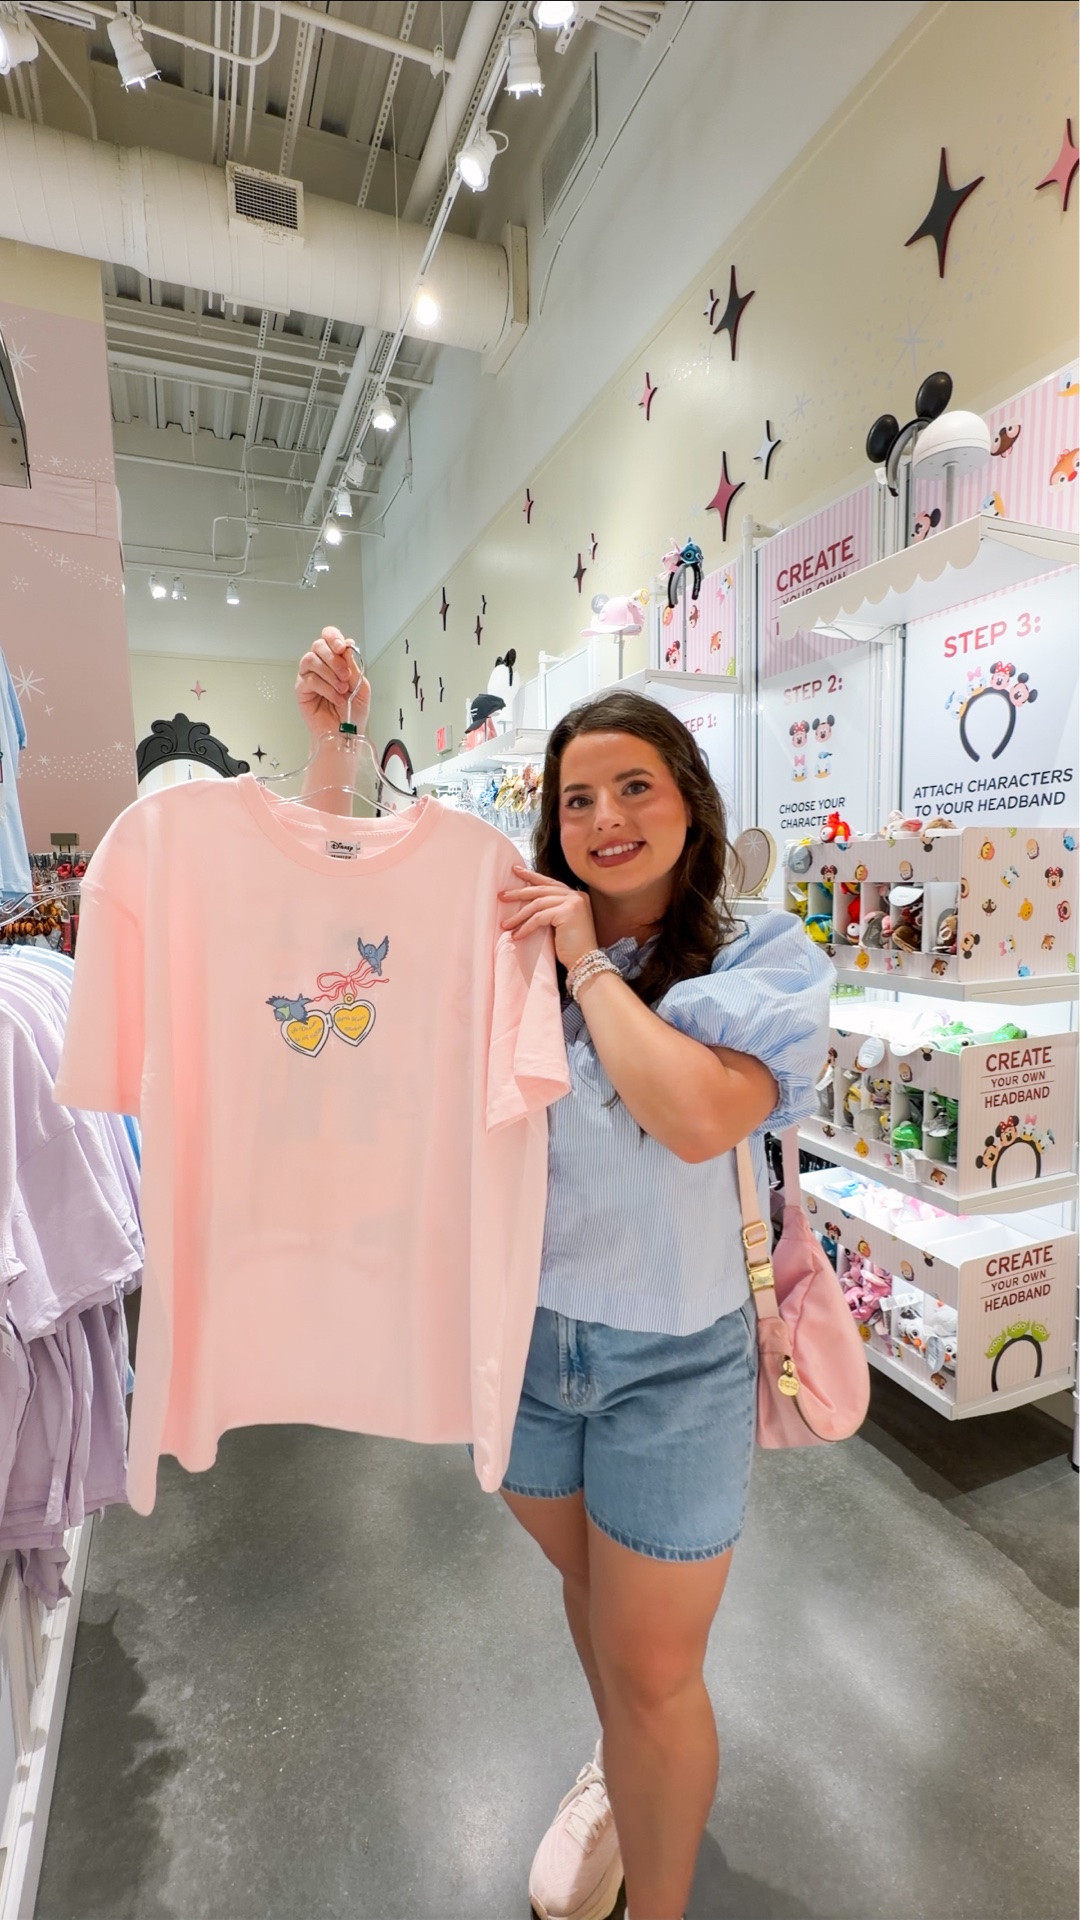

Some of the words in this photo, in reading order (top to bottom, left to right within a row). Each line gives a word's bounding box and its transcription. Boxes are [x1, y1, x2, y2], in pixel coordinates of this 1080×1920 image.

[776, 535, 854, 592] CREATE
[943, 620, 1008, 658] STEP
[1016, 612, 1041, 637] 3:
[783, 679, 823, 706] STEP
[827, 674, 843, 694] 2:
[683, 716, 704, 733] TEP
[707, 713, 717, 729] 1:
[913, 781, 963, 799] ATTACH
[967, 768, 1073, 793] CHARACTERS
[779, 800, 816, 815] CHOOSE
[818, 797, 846, 810] YOUR
[914, 804, 931, 817] TO
[936, 800, 974, 815] YOUR
[977, 791, 1066, 812] HEADBAND
[780, 815, 828, 830] CHARACTE
[330, 840, 354, 853] Disney
[985, 1045, 1052, 1073] CREATE
[991, 1075, 1019, 1088] YOUR
[1022, 1070, 1046, 1083] OWN
[984, 1086, 1050, 1109] HEADBAND
[985, 1244, 1053, 1277] CREATE
[991, 1277, 1019, 1292] YOUR
[1022, 1269, 1047, 1284] OWN
[984, 1283, 1051, 1313] HEADBAND
